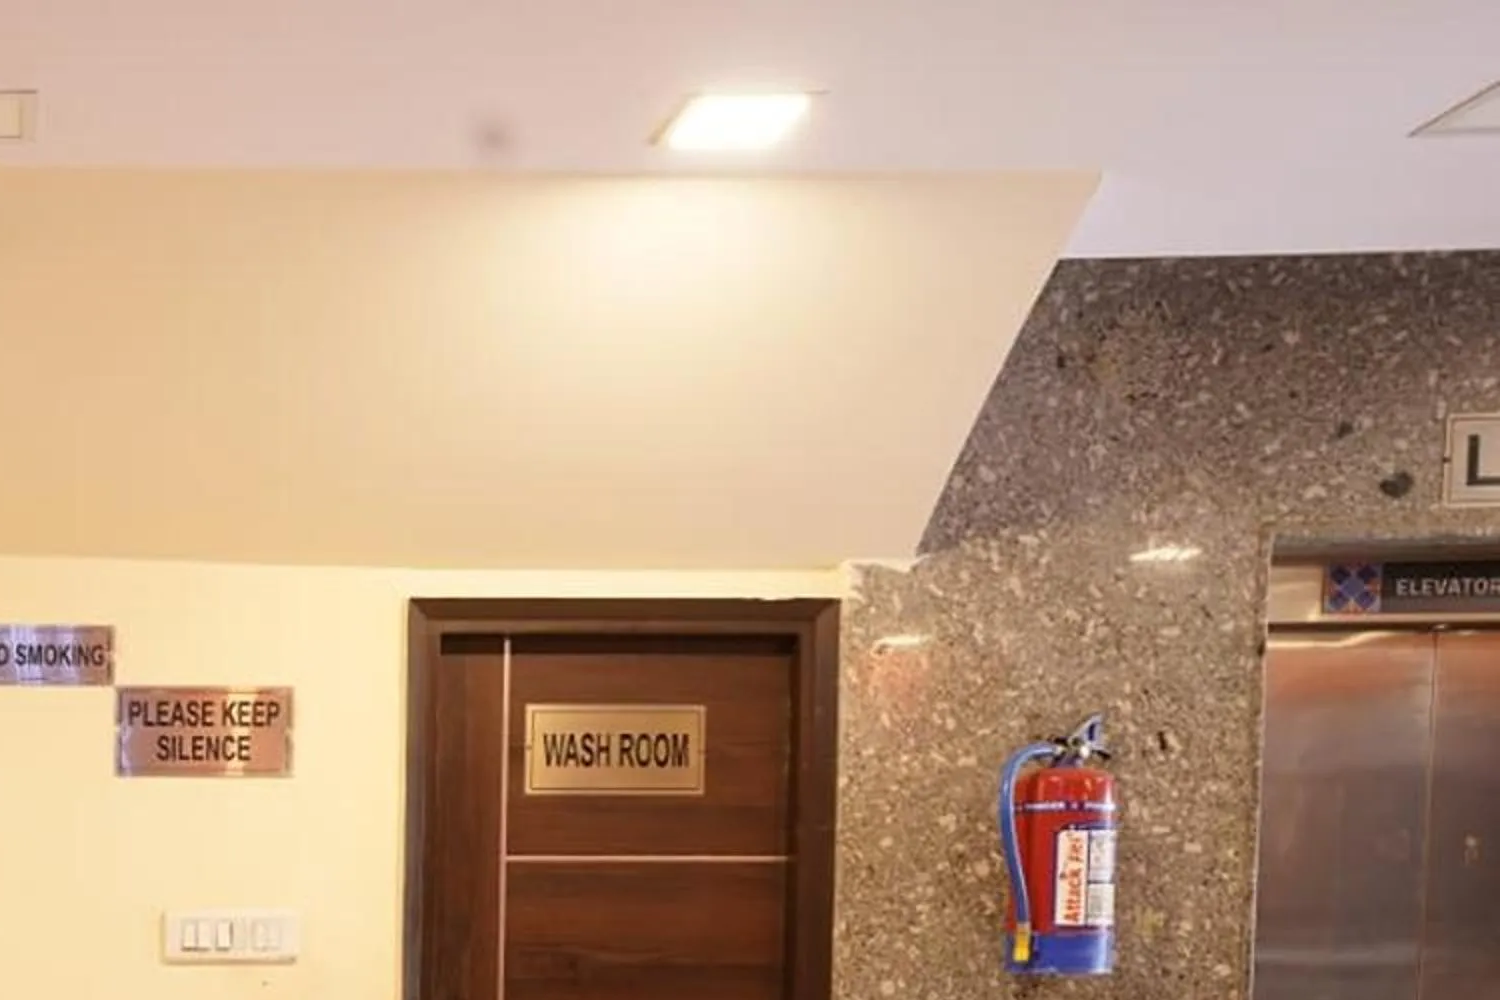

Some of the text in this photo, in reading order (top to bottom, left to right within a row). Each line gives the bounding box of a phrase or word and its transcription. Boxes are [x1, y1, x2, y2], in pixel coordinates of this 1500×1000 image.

[1395, 577, 1500, 597] ELEVATOR
[14, 643, 106, 666] SMOKING
[127, 701, 281, 727] PLEASE KEEP
[156, 735, 252, 761] SILENCE
[543, 732, 690, 768] WASH ROOM
